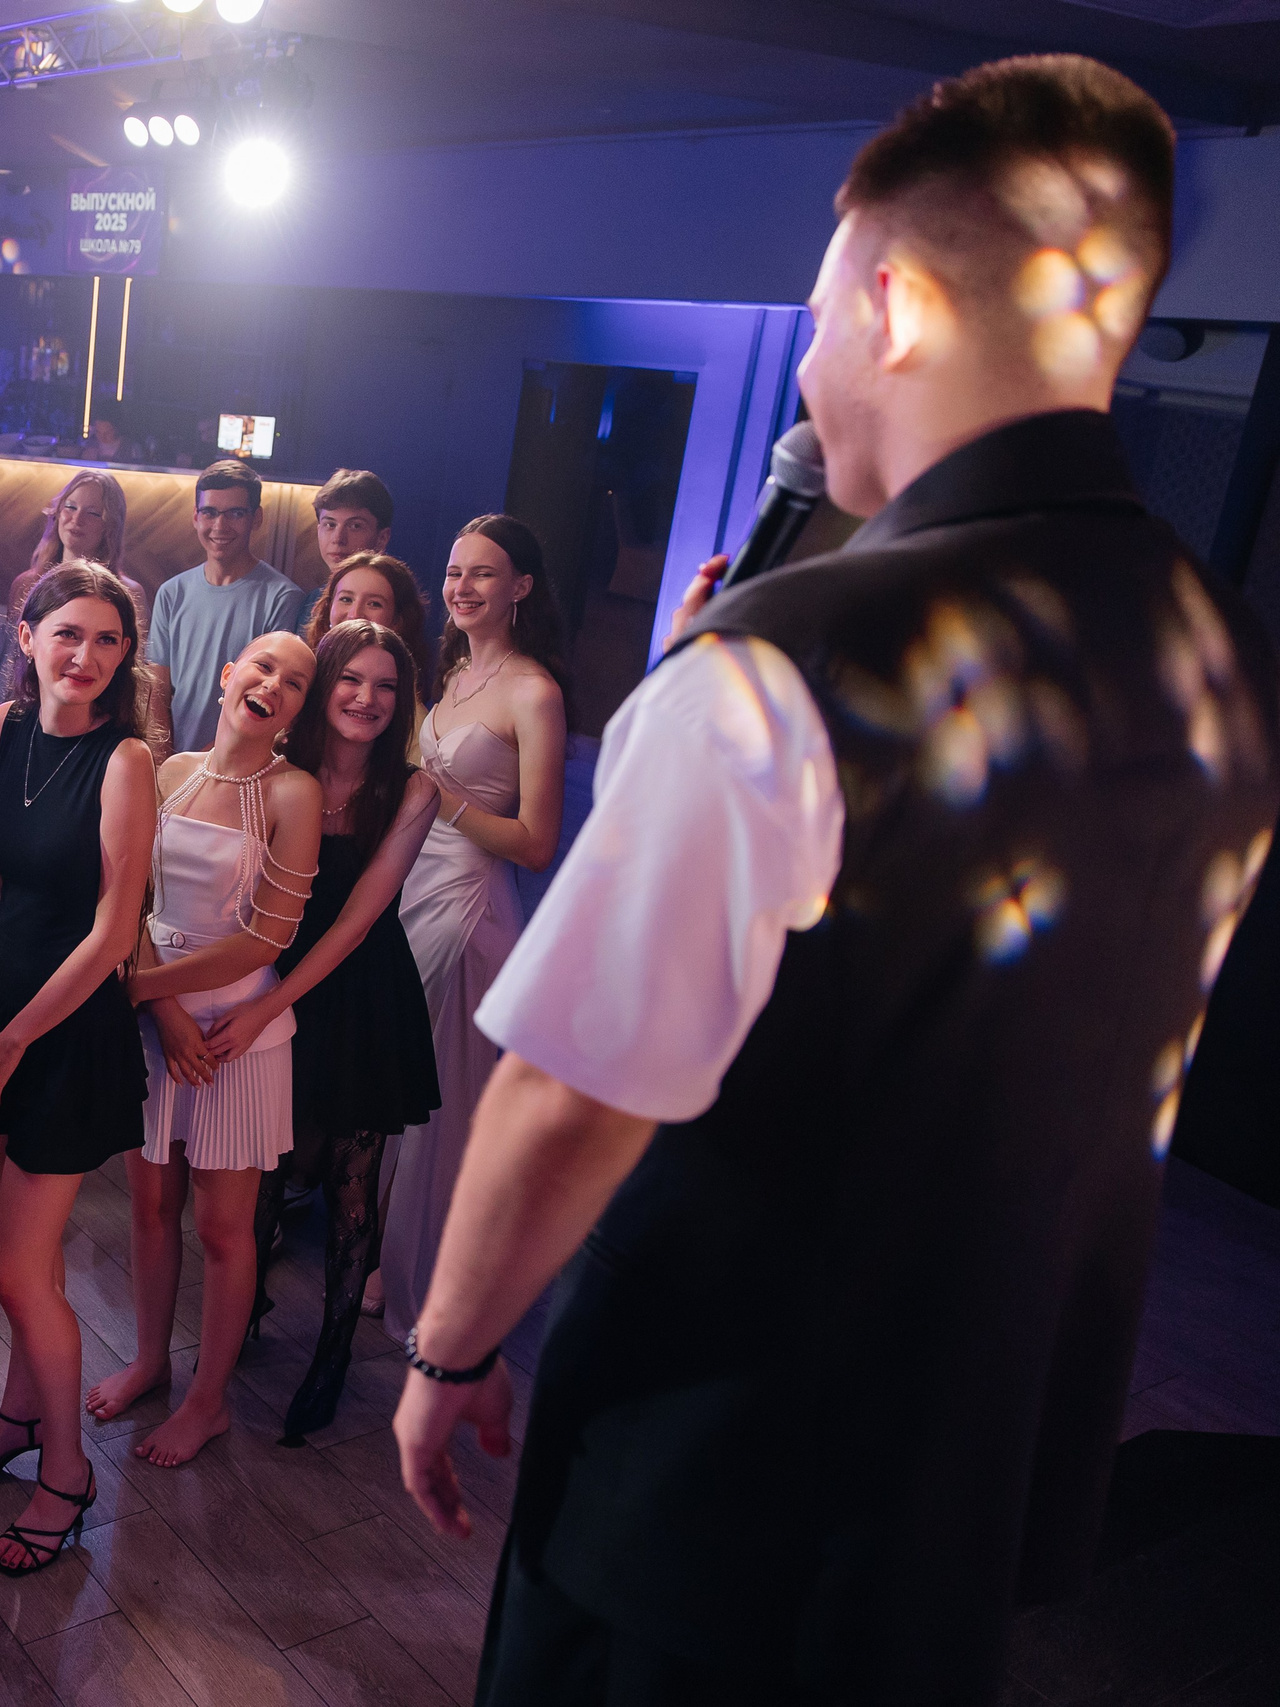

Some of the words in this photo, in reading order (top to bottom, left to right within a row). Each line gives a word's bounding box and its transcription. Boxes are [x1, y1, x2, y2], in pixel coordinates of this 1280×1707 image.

[71, 187, 156, 211] ВЫПУСКНОЙ
[94, 212, 128, 231] 2025
[80, 238, 118, 253] ШКОЛА
